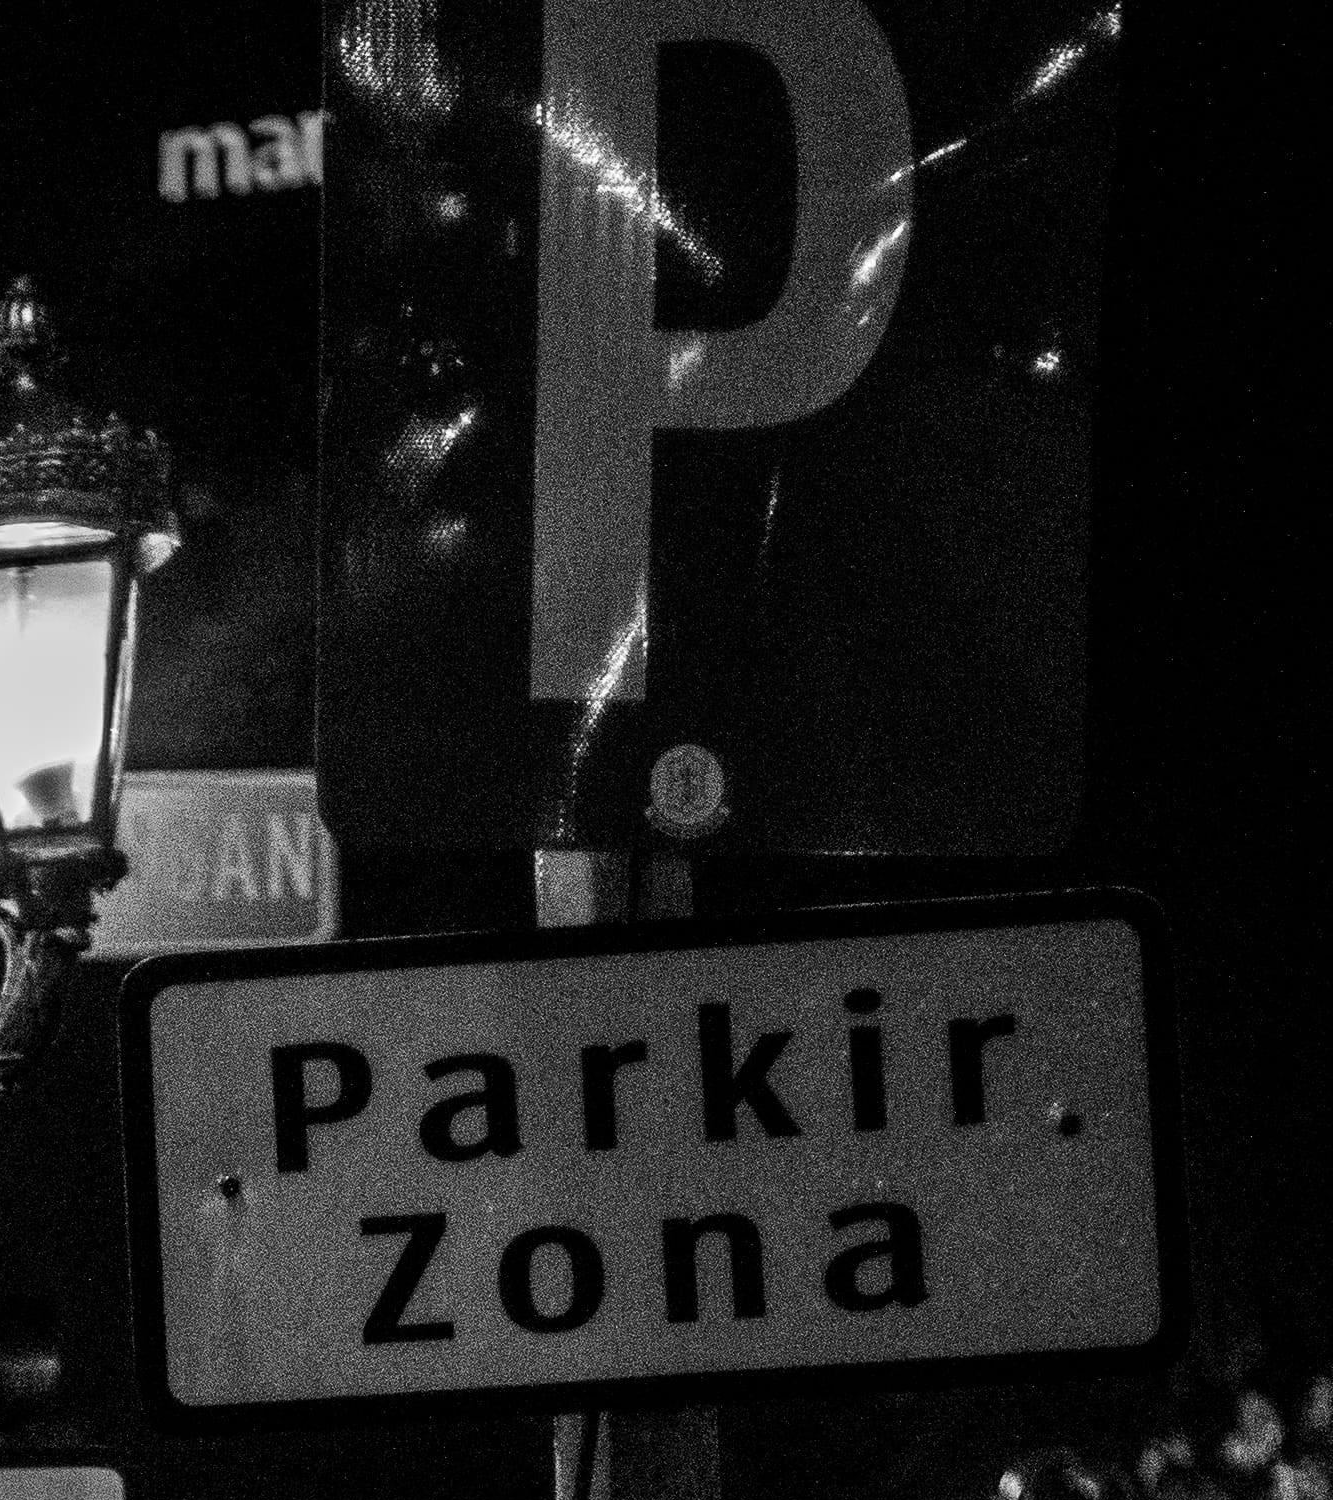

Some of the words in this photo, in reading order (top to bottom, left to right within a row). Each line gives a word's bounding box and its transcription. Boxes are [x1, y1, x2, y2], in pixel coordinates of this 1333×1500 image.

[530, 0, 916, 702] P
[269, 983, 1023, 1175] Parkir
[358, 1196, 933, 1347] Zona
